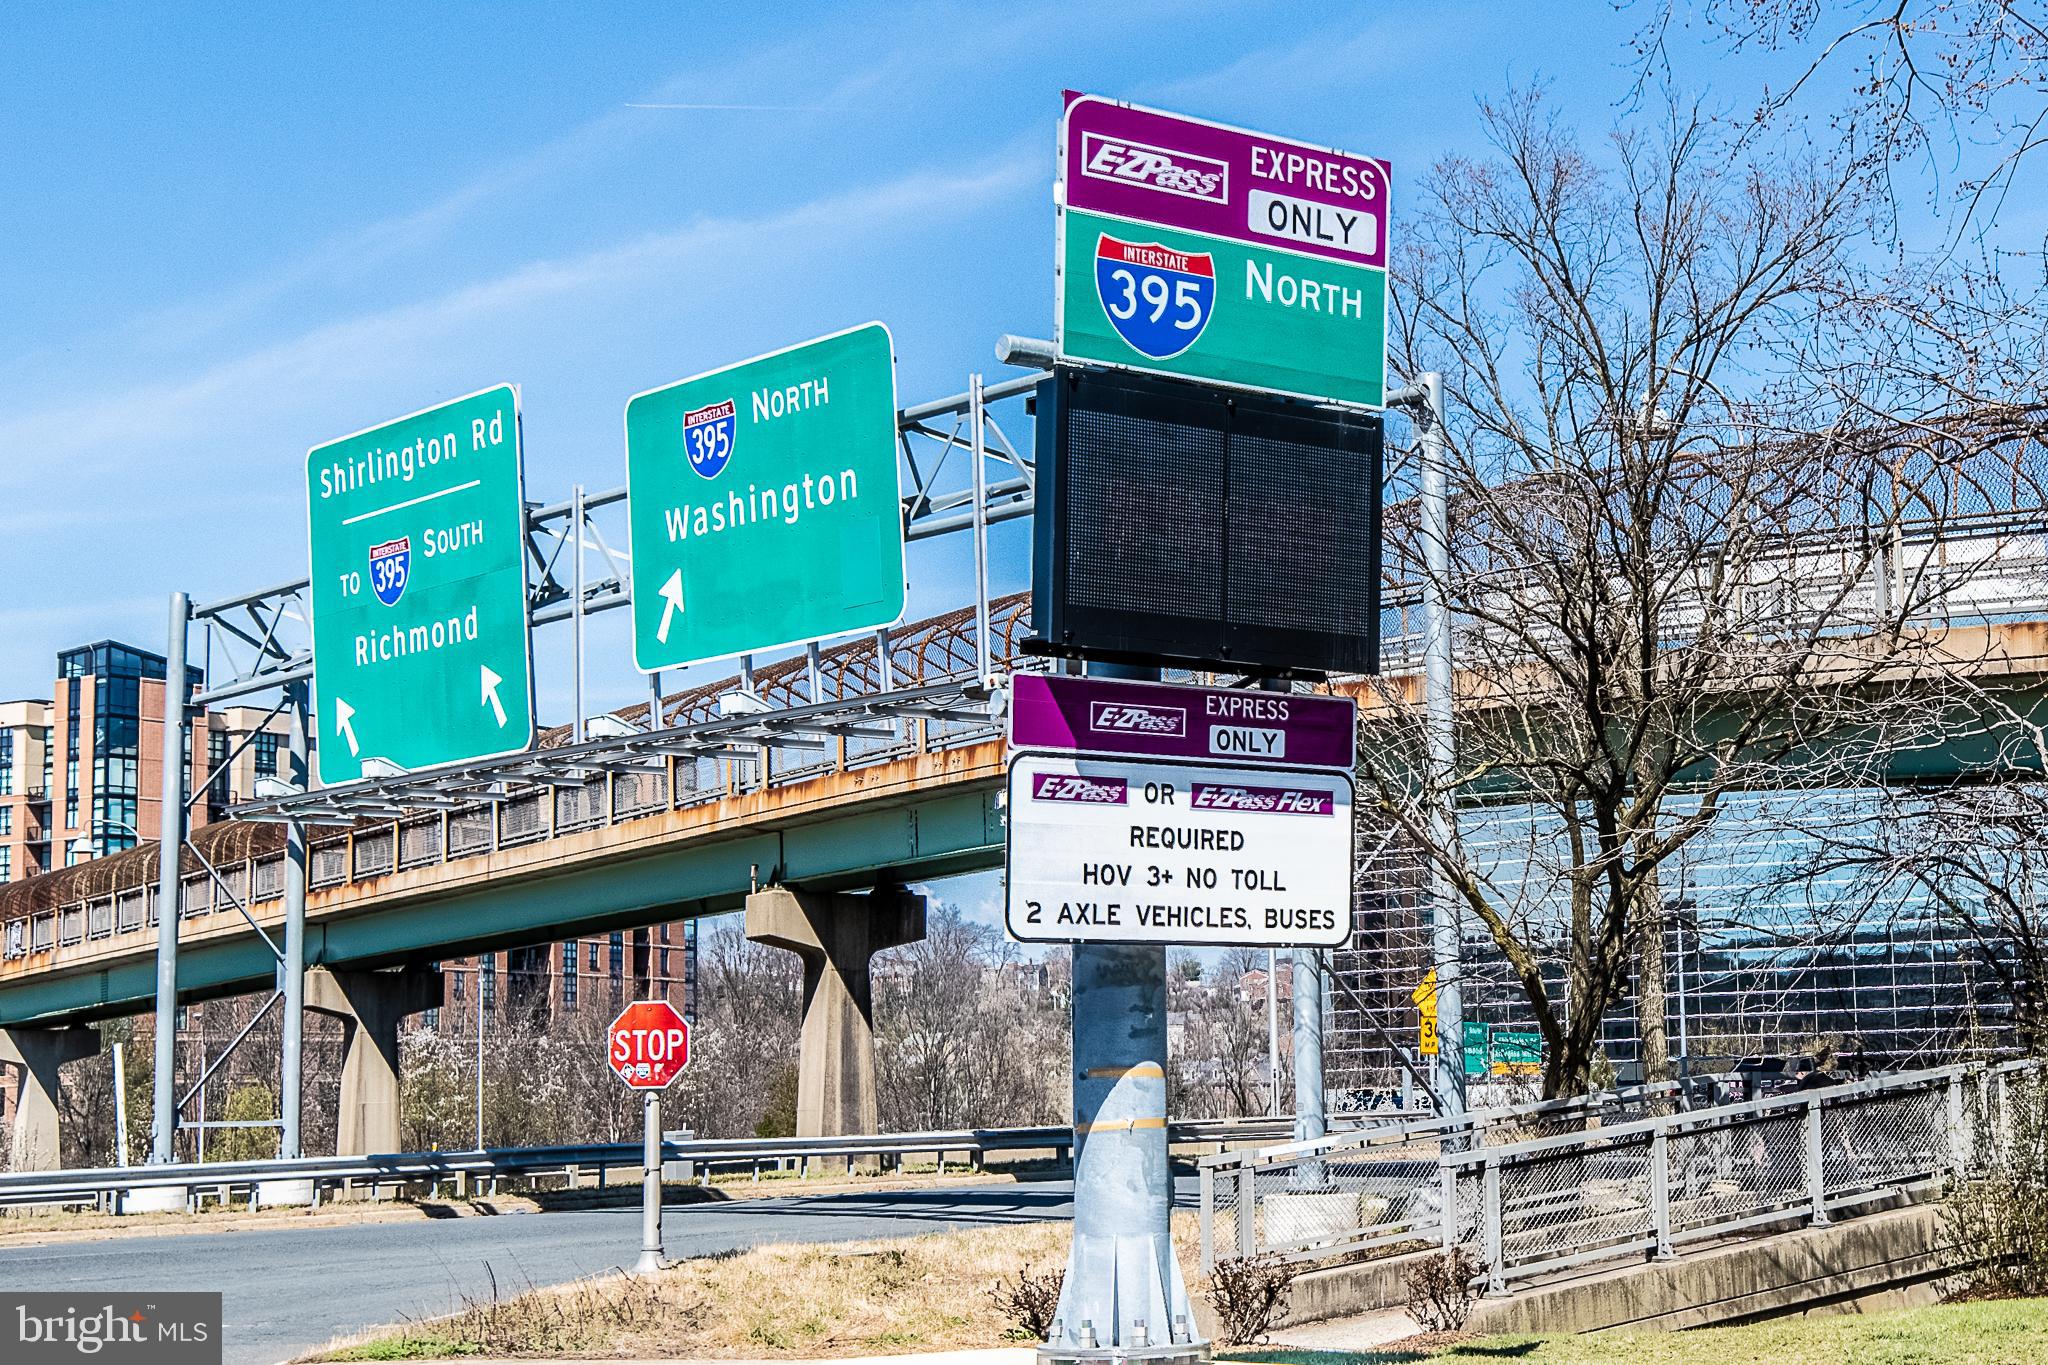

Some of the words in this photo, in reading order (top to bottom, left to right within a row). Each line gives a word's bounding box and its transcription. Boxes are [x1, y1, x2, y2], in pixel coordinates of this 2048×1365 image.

[1251, 146, 1376, 200] EXPRESS
[1268, 200, 1358, 244] ONLY
[1123, 245, 1189, 271] INTERSTATE
[1109, 269, 1202, 330] 395
[1246, 259, 1362, 319] NORTH
[687, 404, 730, 426] INTERSTATE
[751, 377, 829, 423] NORTH
[320, 431, 457, 499] Shirlington
[471, 409, 504, 452] Rd
[692, 421, 729, 465] 395
[665, 468, 858, 543] Washington
[372, 541, 407, 559] INTERSTATE
[423, 519, 484, 558] SOUTH
[339, 571, 361, 597] TO
[375, 556, 406, 591] 395
[355, 605, 478, 667] Richmond
[1206, 695, 1289, 721] EXPRESS
[1216, 729, 1278, 754] ONLY
[1144, 782, 1175, 806] OR
[1276, 790, 1323, 813] Flex
[1130, 826, 1245, 852] REQUIRED
[1083, 863, 1132, 887] HOV
[1147, 865, 1173, 888] 3+
[1187, 867, 1217, 890] NO
[1232, 869, 1286, 892] TOLL
[1025, 900, 1042, 925] 2
[1057, 902, 1121, 926] AXLE
[1136, 904, 1252, 930] VEHICLES,
[1265, 908, 1336, 931] BUSES
[614, 1029, 684, 1062] STOP
